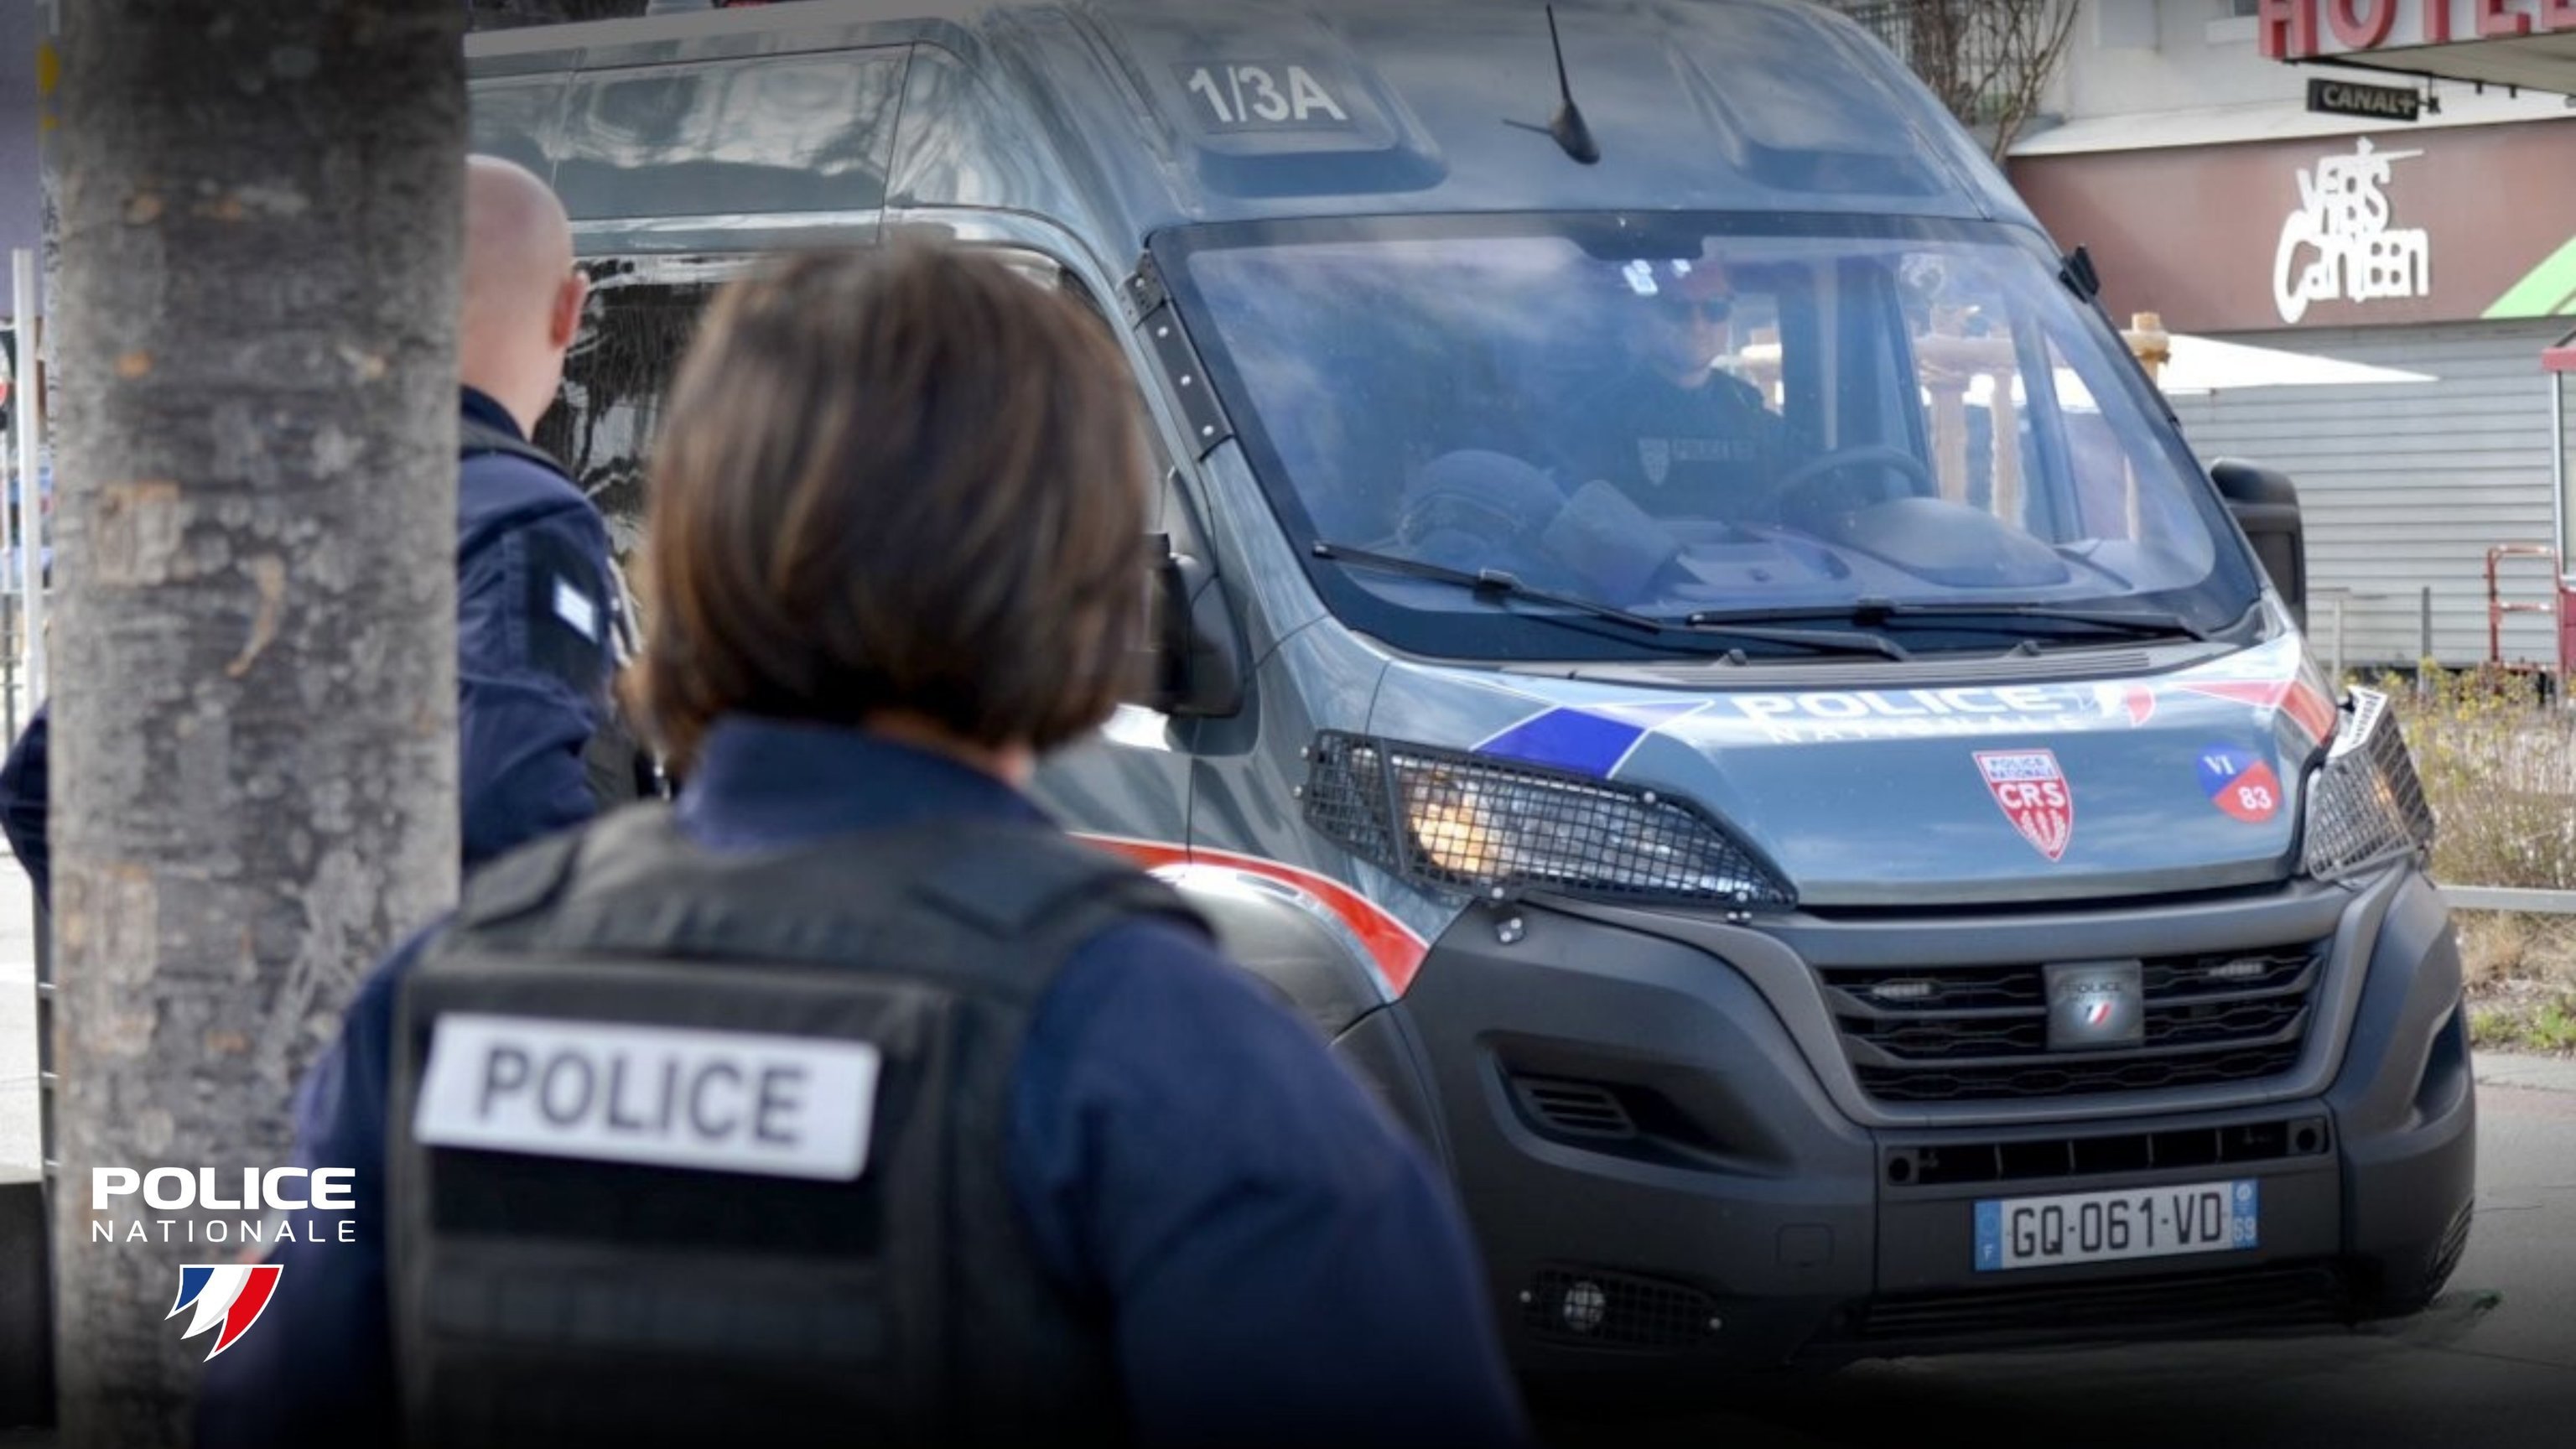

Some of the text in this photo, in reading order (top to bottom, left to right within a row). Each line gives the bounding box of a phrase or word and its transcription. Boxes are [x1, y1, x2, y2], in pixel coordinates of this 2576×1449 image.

[1187, 65, 1348, 122] 1/3A
[2321, 86, 2416, 114] CANAL+
[1732, 686, 2062, 722] POLICE
[2203, 755, 2236, 775] VI
[1999, 782, 2065, 809] CRS
[2238, 787, 2272, 809] 83
[476, 1046, 808, 1147] POLICE
[2233, 1217, 2257, 1241] 69
[1983, 1244, 1993, 1261] F
